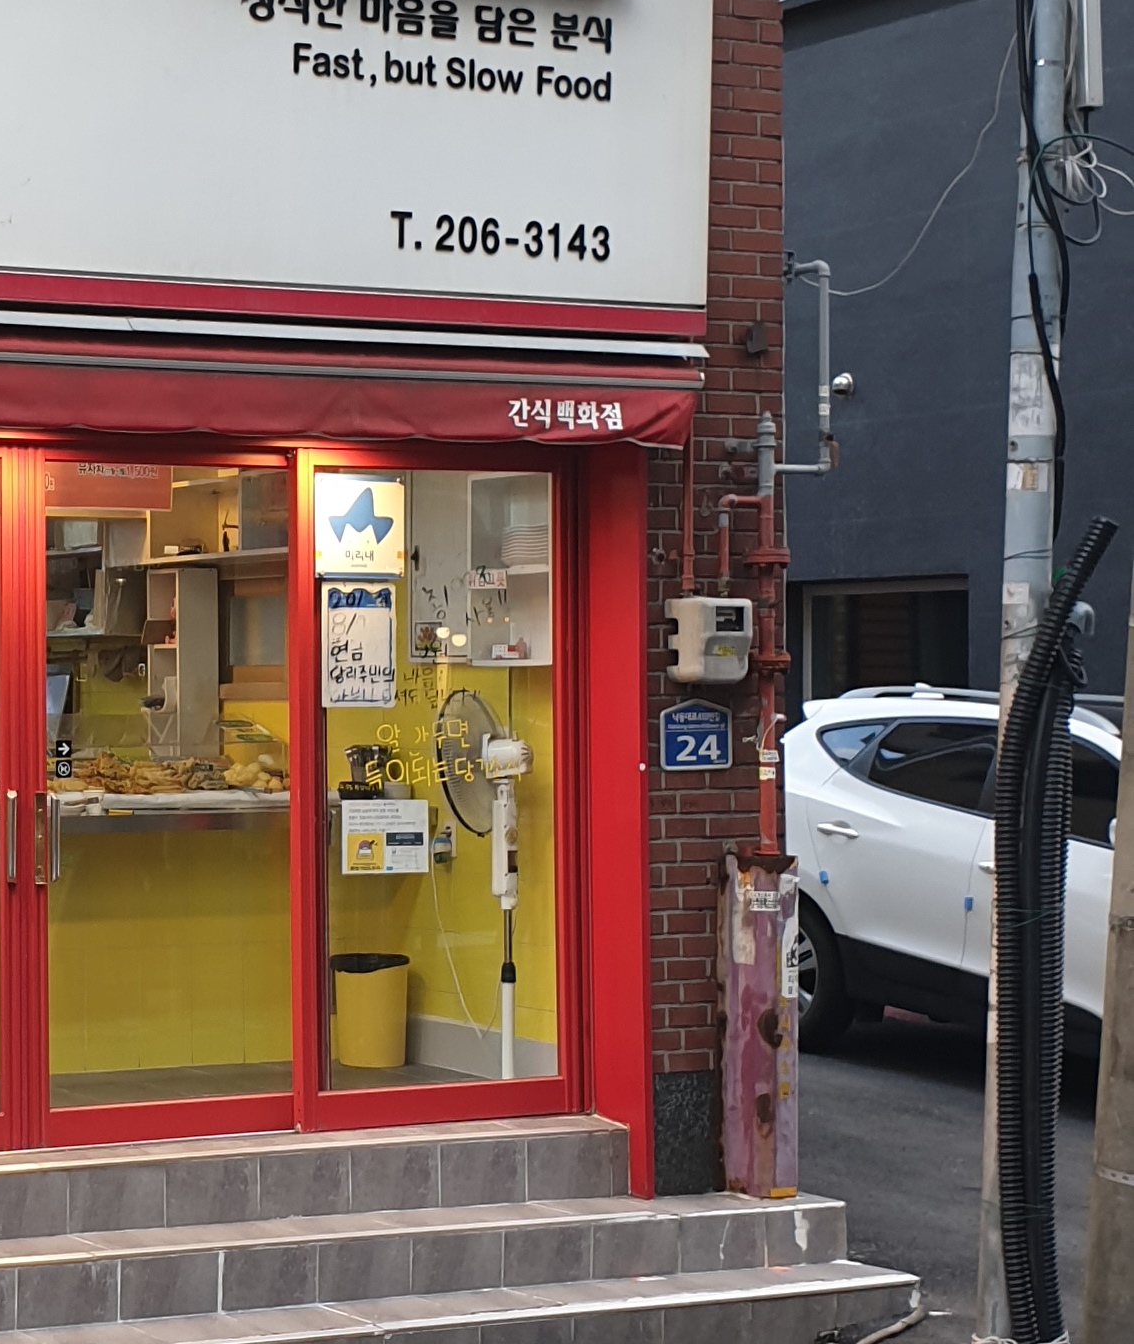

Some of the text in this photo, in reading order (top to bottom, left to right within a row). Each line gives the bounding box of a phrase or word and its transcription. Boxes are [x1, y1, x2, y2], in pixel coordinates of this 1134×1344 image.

[474, 5, 537, 47] 담은
[551, 12, 613, 54] 분식
[293, 42, 612, 102] Fast, but Slow Food
[391, 211, 611, 262] T. 206-3143
[345, 549, 375, 563] 미리내
[676, 734, 721, 761] 24
